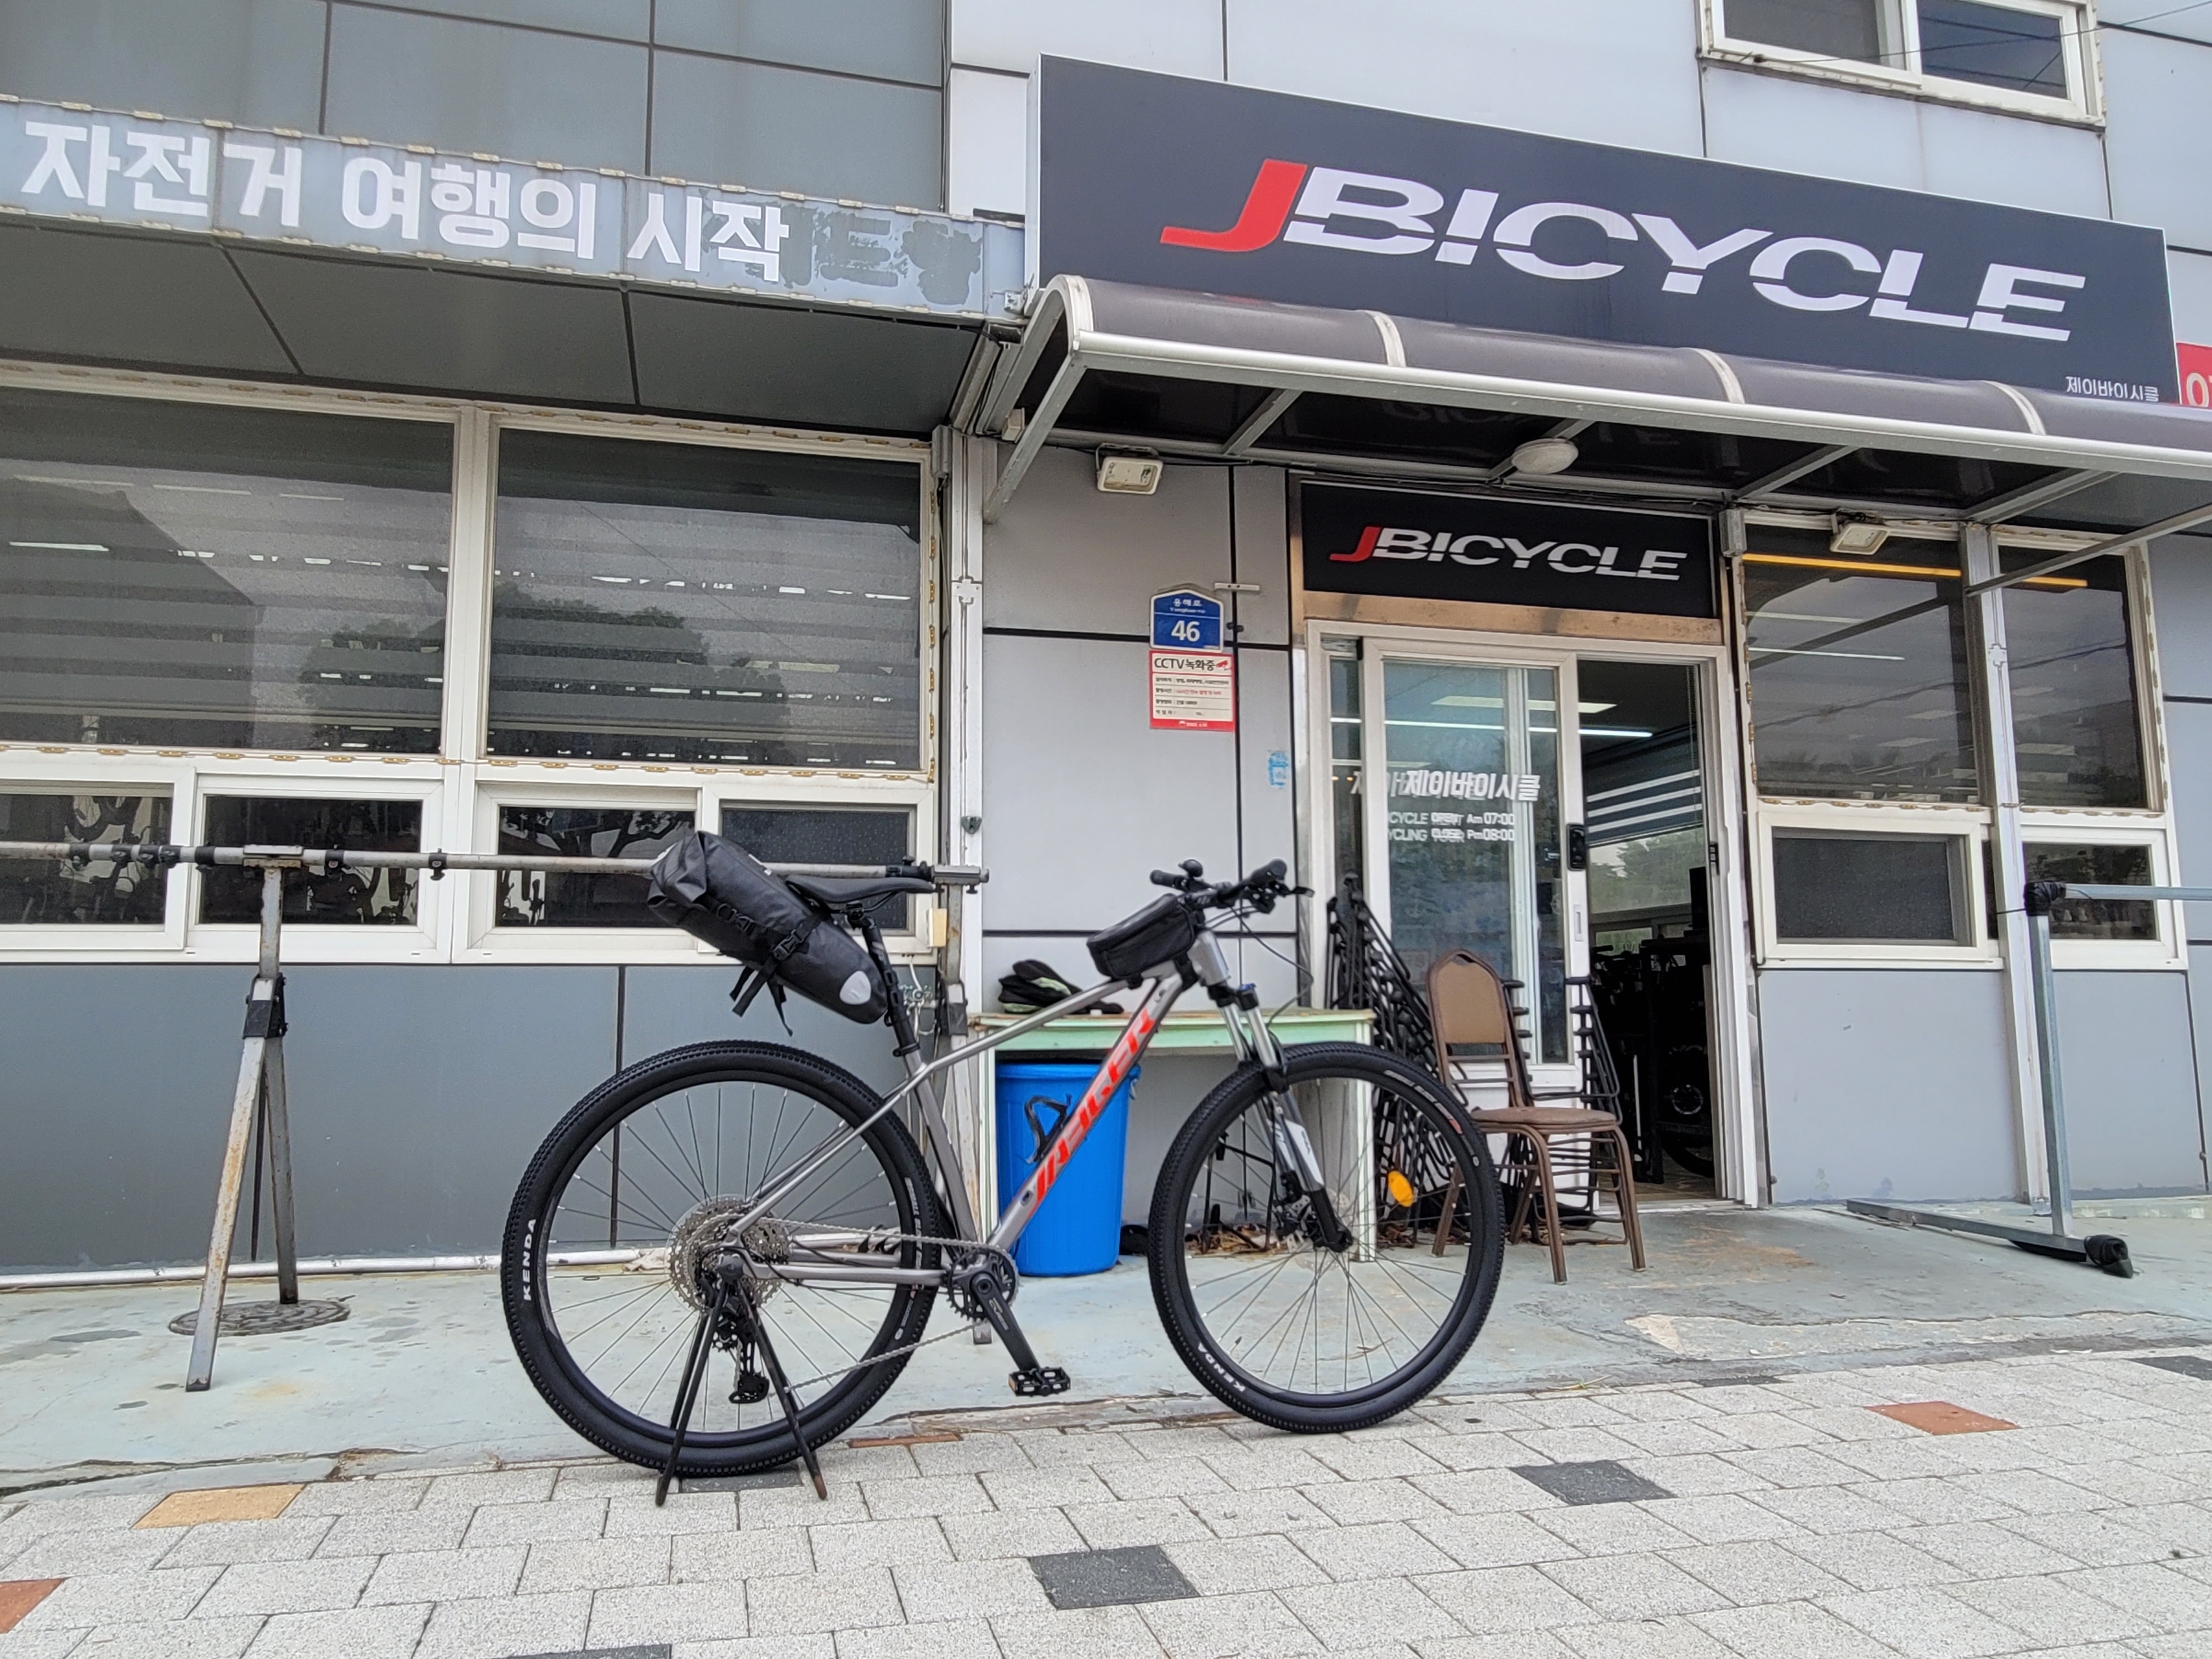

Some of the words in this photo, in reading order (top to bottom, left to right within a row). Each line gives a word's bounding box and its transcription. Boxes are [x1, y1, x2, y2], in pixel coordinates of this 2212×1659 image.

[21, 122, 302, 227] 자전거
[342, 157, 596, 259] 여행의
[627, 193, 789, 282] 시작
[1160, 159, 2085, 341] JBICYCLE
[2065, 376, 2159, 402] 제이바이시클
[1330, 526, 1687, 580] JBICYCLE
[1171, 620, 1200, 642] 46
[522, 1219, 537, 1301] KENDA
[1198, 1342, 1246, 1392] KENDA
